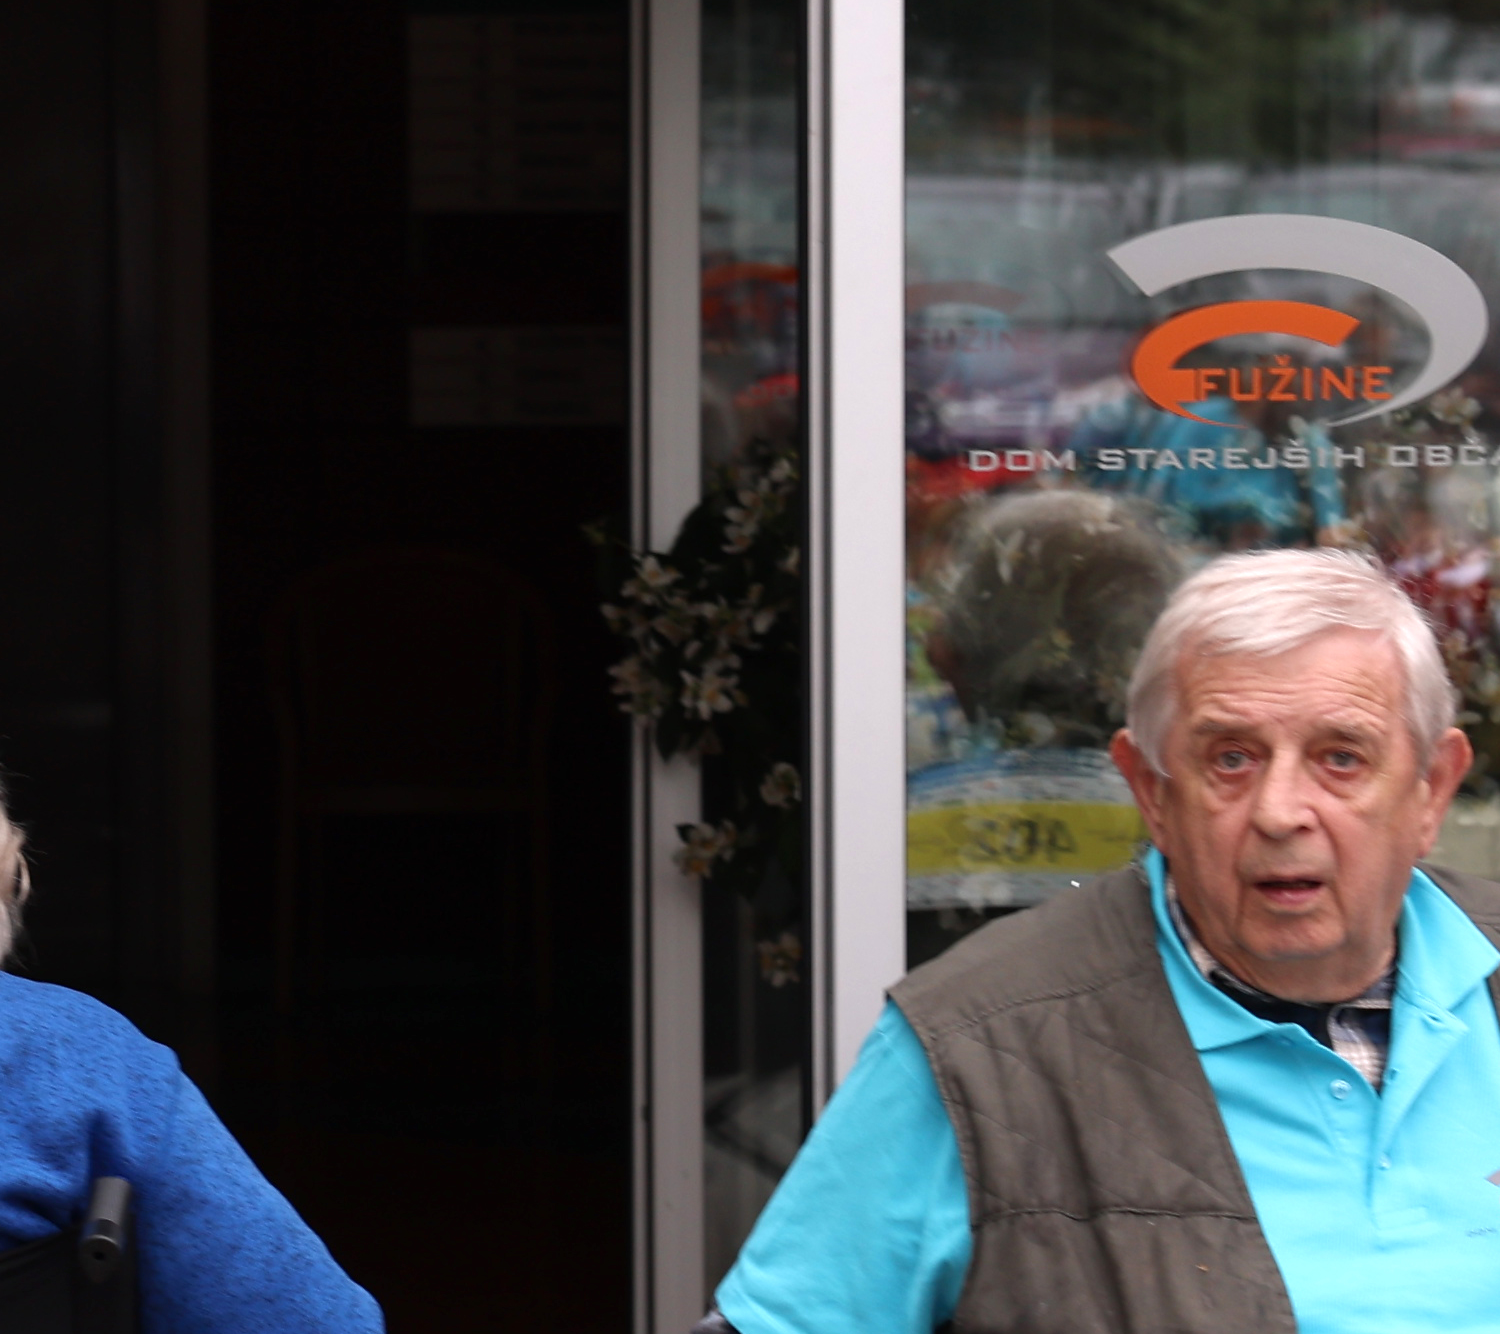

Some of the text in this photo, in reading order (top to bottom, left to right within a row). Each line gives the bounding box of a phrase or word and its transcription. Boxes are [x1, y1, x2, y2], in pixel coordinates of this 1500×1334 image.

[1196, 355, 1394, 402] FUŽINE
[968, 447, 1077, 471] DOM
[1097, 438, 1365, 471] STAREJŠIH
